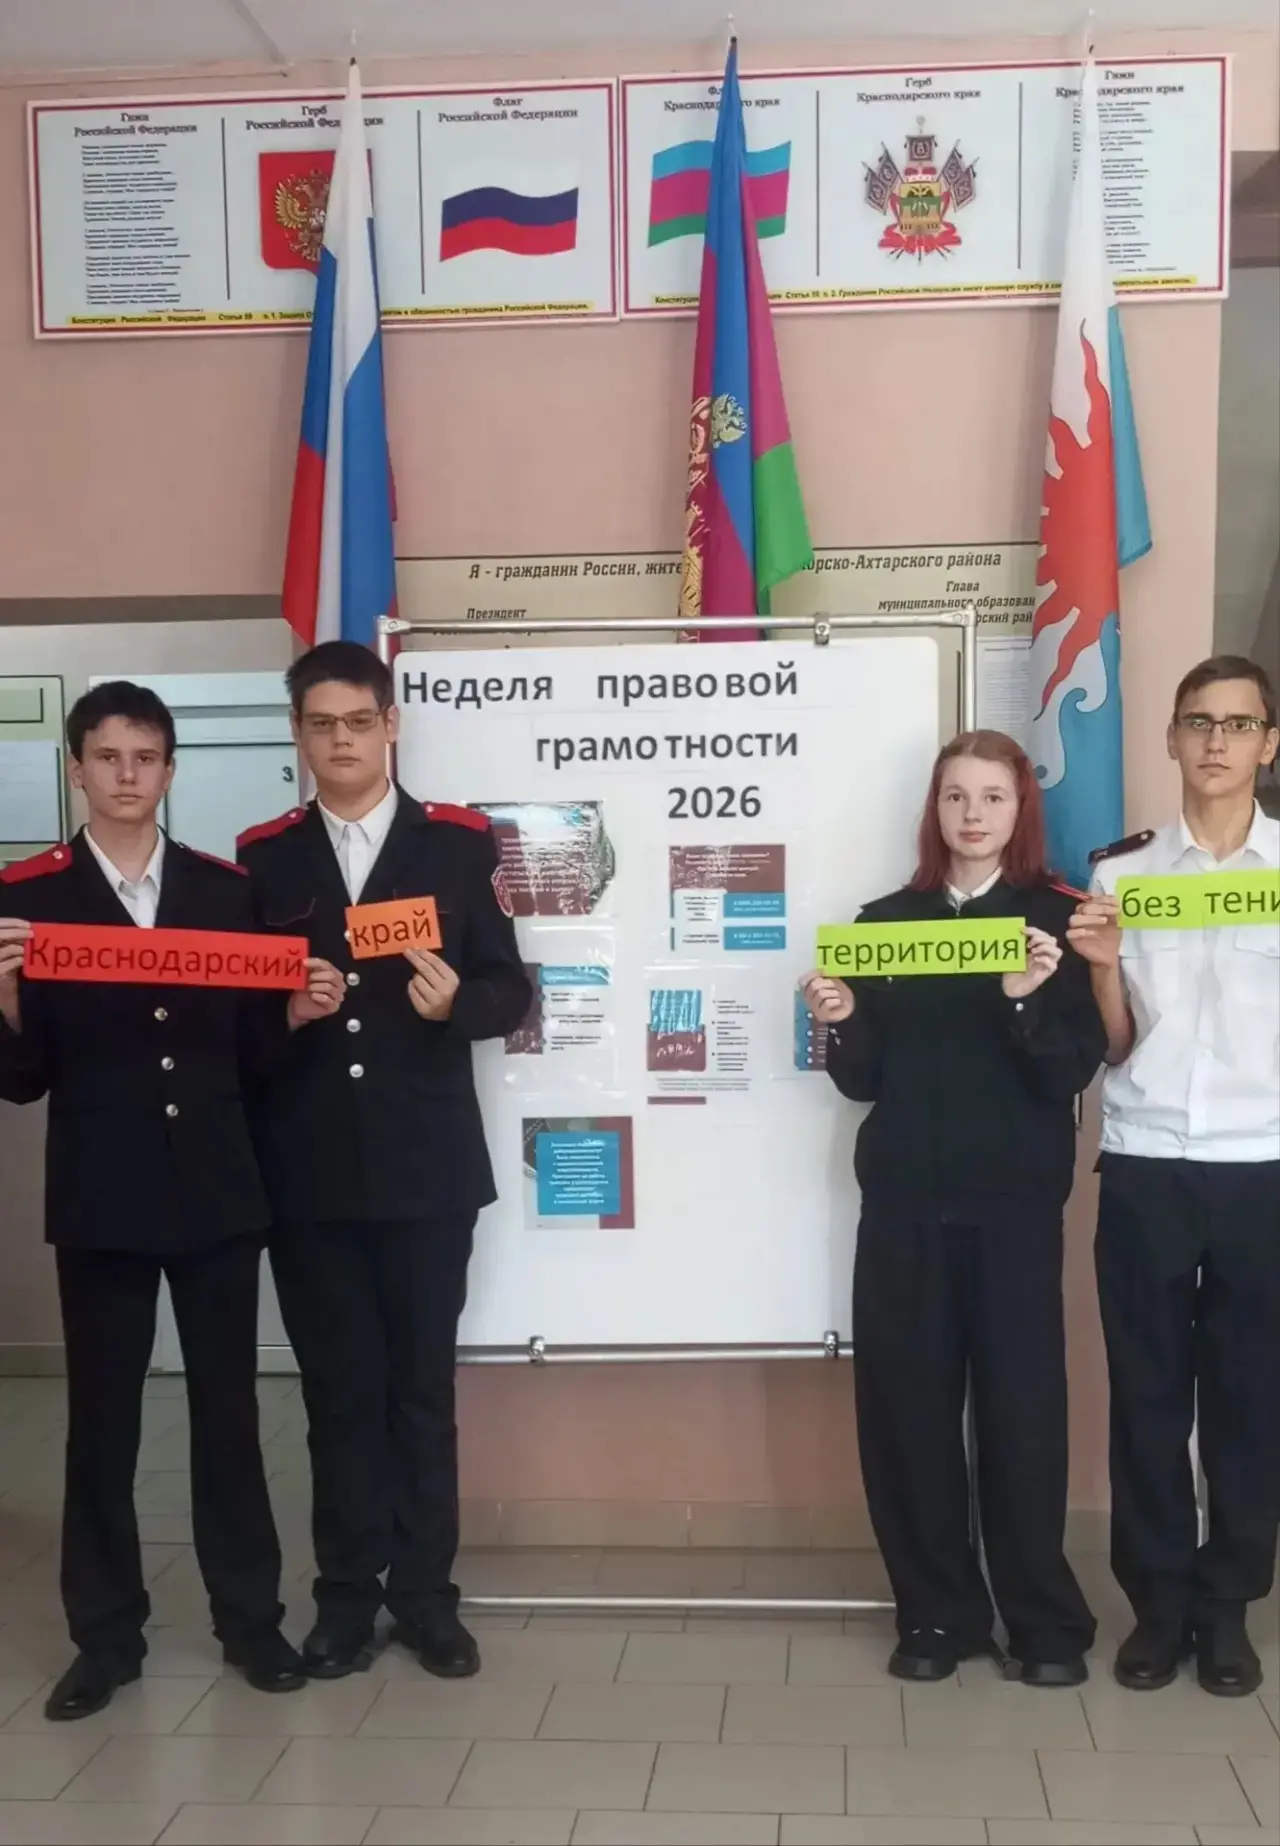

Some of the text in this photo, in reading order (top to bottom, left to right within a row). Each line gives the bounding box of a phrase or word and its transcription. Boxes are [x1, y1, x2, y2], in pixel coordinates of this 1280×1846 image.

[905, 77, 932, 89] Герб
[857, 90, 981, 103] Краснодарского края
[1156, 85, 1185, 96] края
[492, 97, 523, 106] Флаг
[754, 99, 780, 109] края
[301, 105, 328, 117] Герб
[438, 108, 578, 123] Российской Федерации
[74, 123, 198, 138] Российской Федерации
[245, 118, 315, 130] Российской
[469, 564, 481, 580] Я
[495, 564, 579, 582] гражданин
[583, 561, 641, 578] России,
[645, 562, 682, 575] жите
[946, 552, 1002, 571] района
[946, 580, 980, 593] Глава
[976, 596, 1036, 610] образован
[466, 607, 527, 620] Президент
[403, 671, 553, 709] Неделя
[536, 731, 798, 770] грамотности
[668, 786, 762, 819] 2026
[1122, 888, 1181, 917] без
[353, 910, 432, 951] край
[28, 938, 301, 979] Краснодарский
[817, 936, 1020, 971] территория
